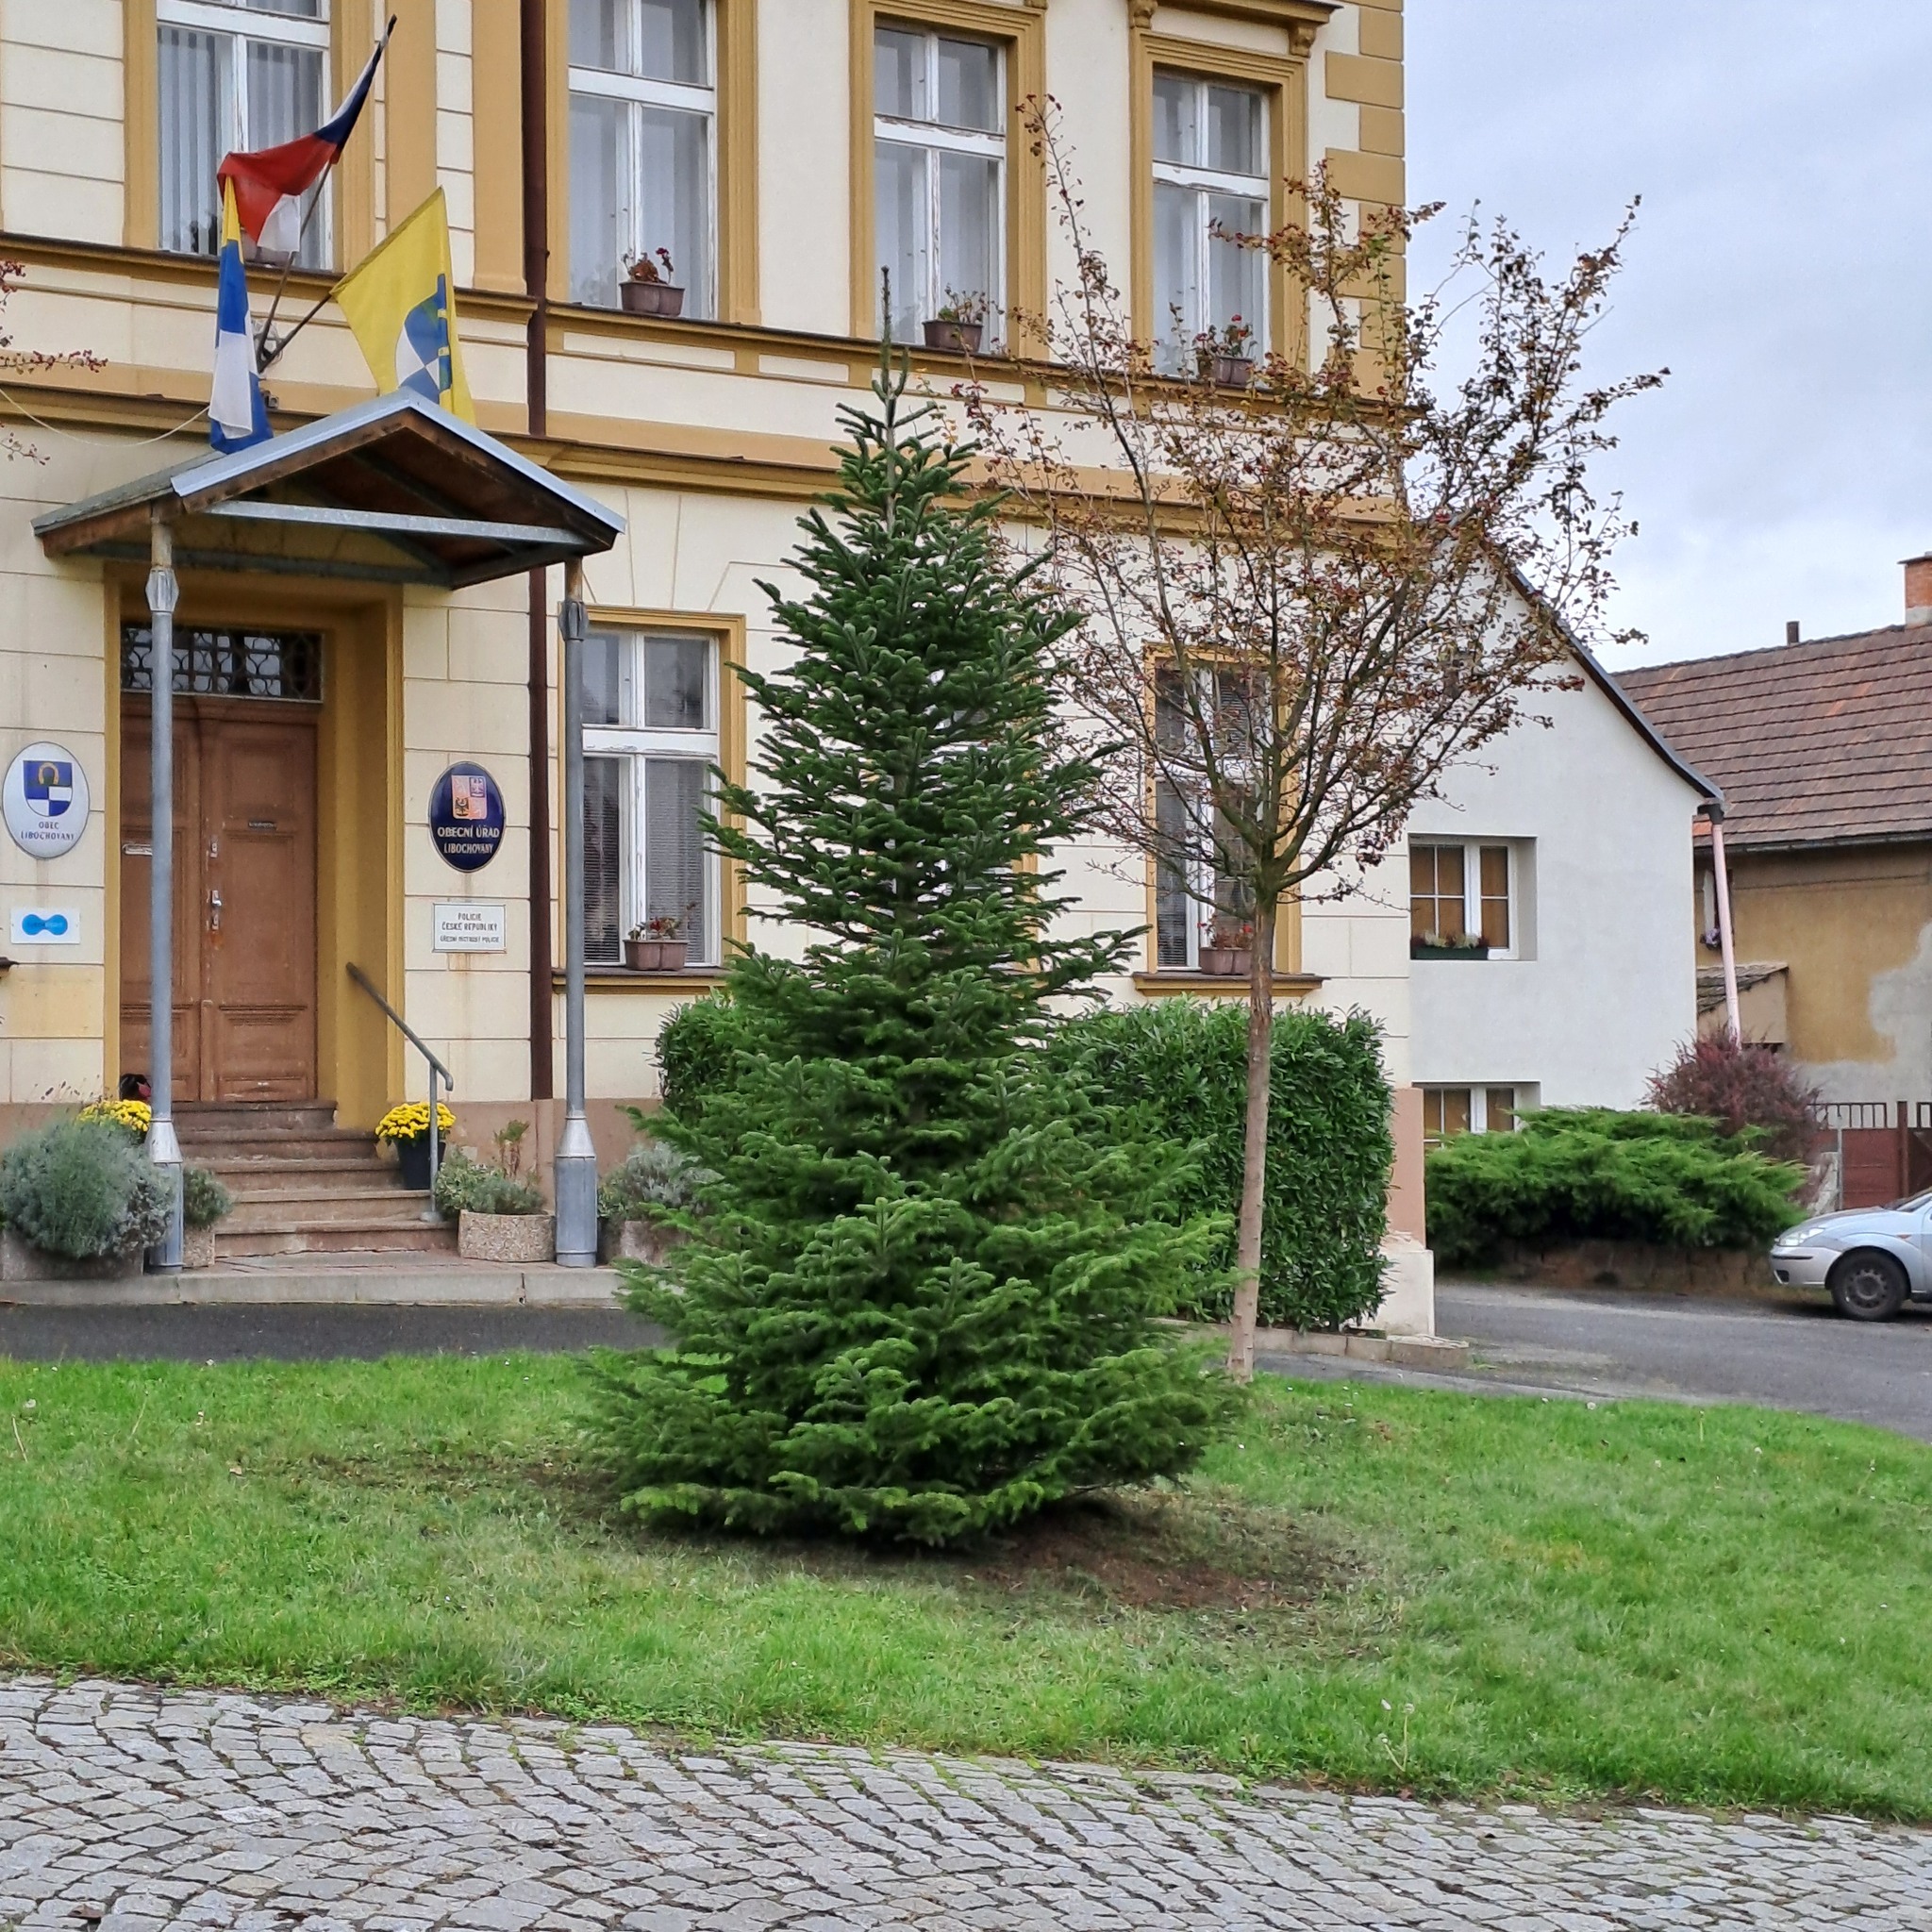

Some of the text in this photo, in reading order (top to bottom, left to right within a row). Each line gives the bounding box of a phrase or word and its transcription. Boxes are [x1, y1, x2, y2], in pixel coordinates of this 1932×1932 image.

[39, 821, 58, 830] OBEC
[437, 824, 474, 838] OBECNÍ
[443, 842, 494, 854] LIBOCHOVANY
